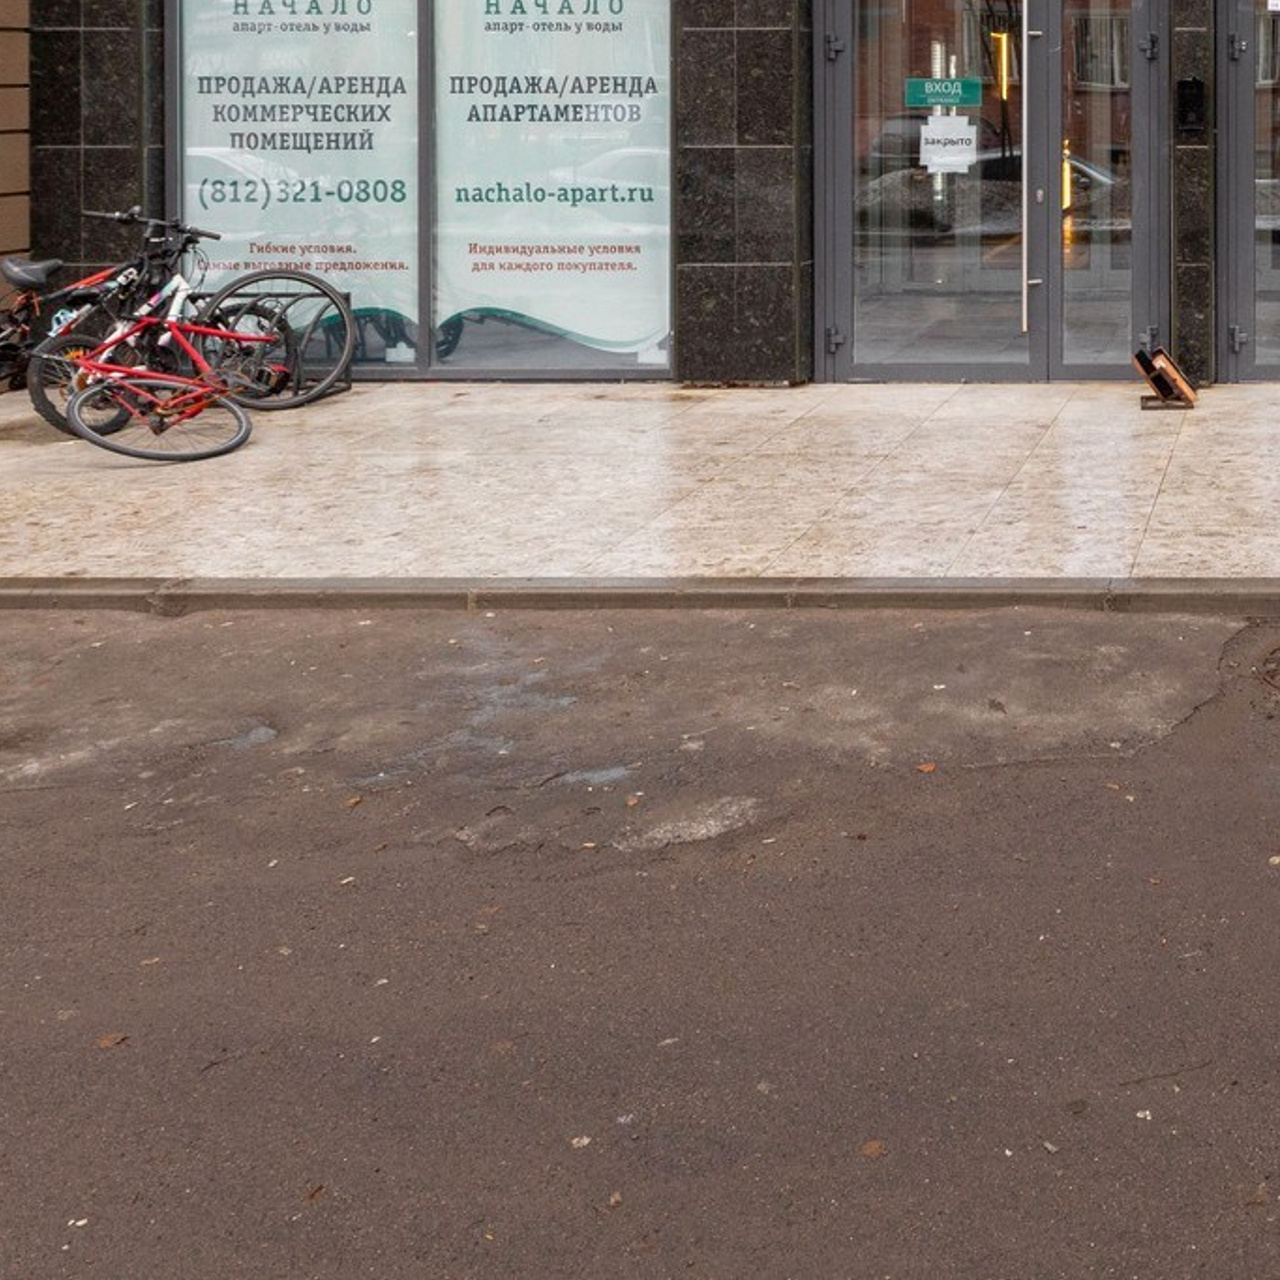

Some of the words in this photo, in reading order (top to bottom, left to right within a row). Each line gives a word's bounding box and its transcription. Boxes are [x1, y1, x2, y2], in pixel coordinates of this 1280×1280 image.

[232, 21, 319, 34] апарт-отель
[323, 23, 331, 35] у
[333, 22, 371, 33] воды
[574, 23, 582, 34] у
[586, 22, 623, 33] воды
[197, 76, 407, 98] ПРОДАЖА/АРЕНДА
[449, 75, 659, 98] ПРОДАЖА/АРЕНДА
[925, 81, 962, 95] ВХОД
[212, 104, 392, 122] КОММЕРЧЕСКИХ
[467, 104, 642, 122] АПАРТАМЕНТОВ
[230, 129, 375, 153] ПОМЕЩЕНИЙ
[924, 137, 973, 148] закрыто
[199, 178, 407, 210] (812)321-0808
[455, 182, 655, 207] nachalo-apart.ru
[249, 242, 296, 254] Гибкие
[299, 244, 357, 256] условия.
[468, 243, 585, 256] Индивидуальные
[588, 244, 641, 256] условия
[244, 261, 311, 271] выгодные
[315, 261, 409, 272] предложения.
[471, 262, 495, 272] для
[499, 261, 553, 272] каждого
[557, 261, 637, 273] покупателя.
